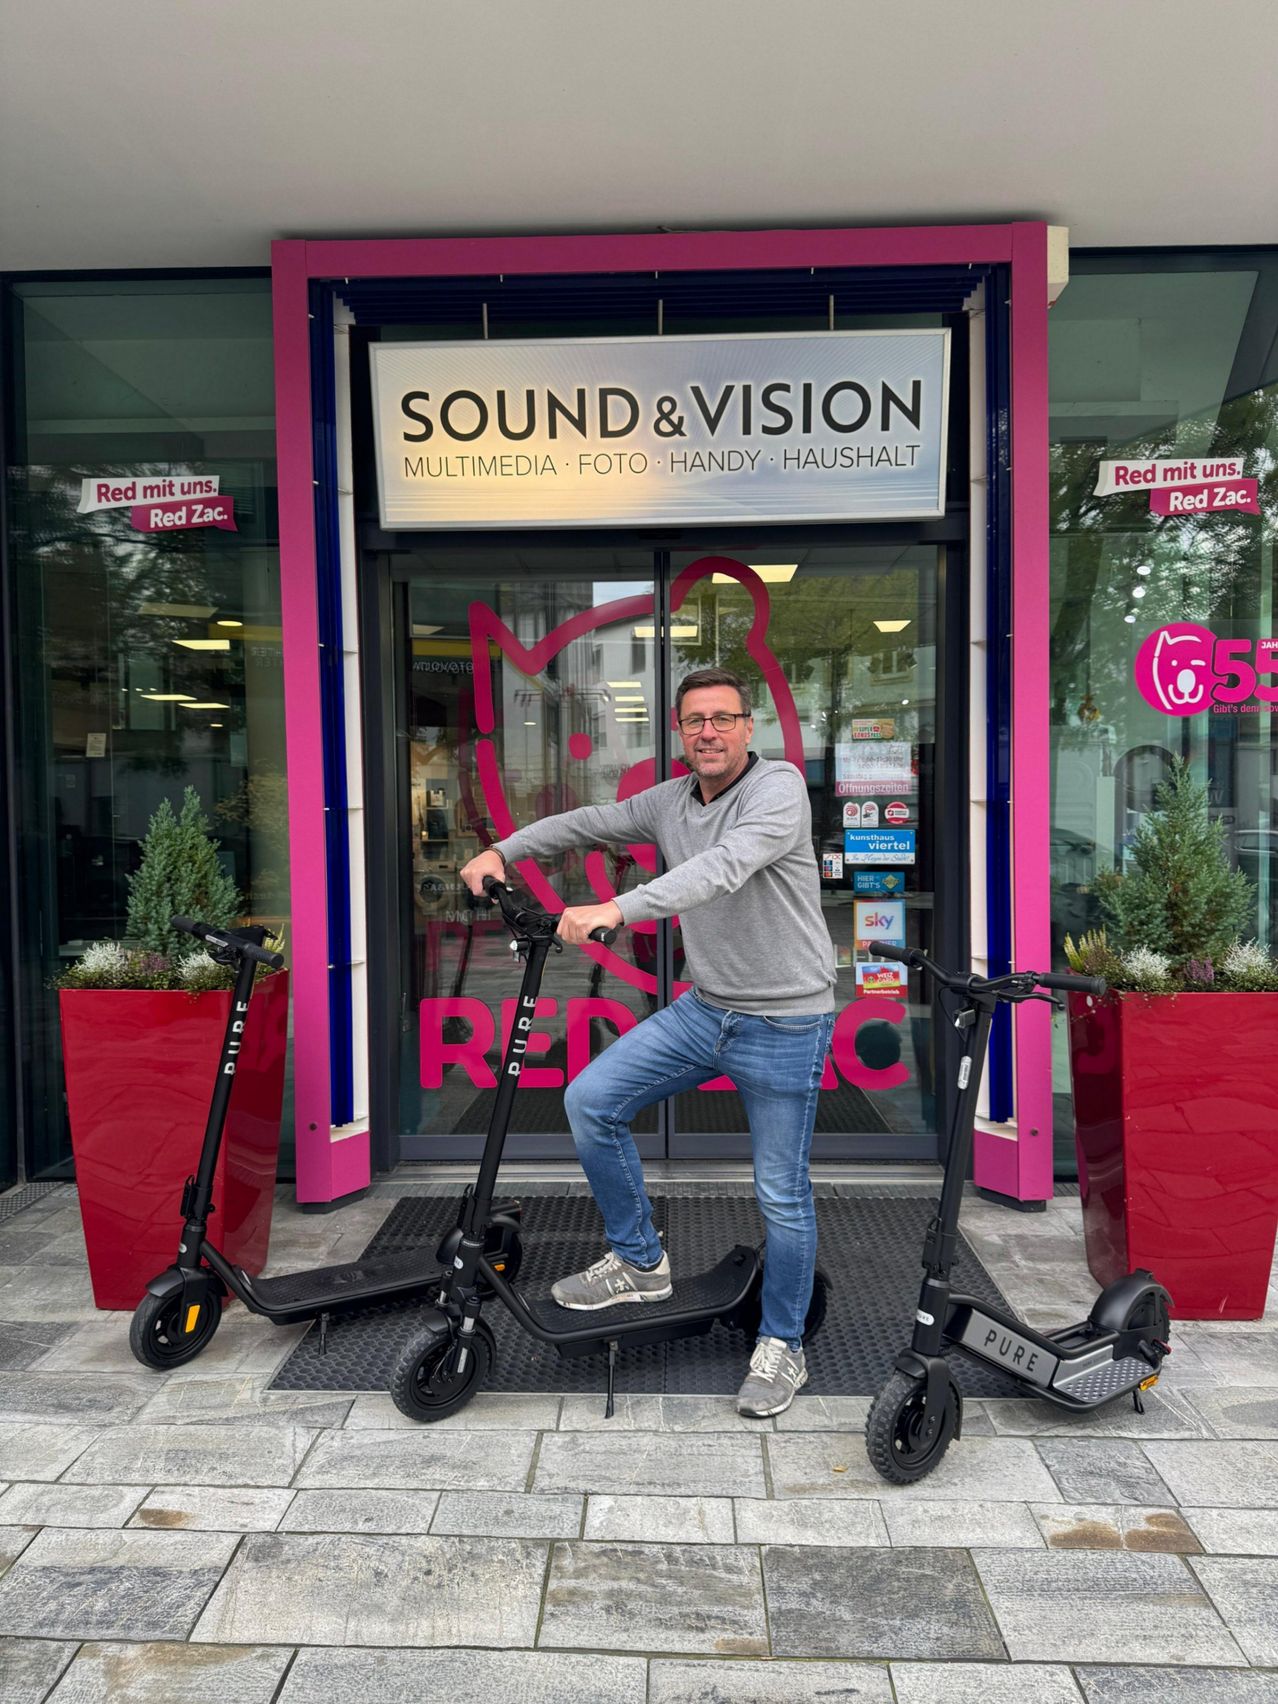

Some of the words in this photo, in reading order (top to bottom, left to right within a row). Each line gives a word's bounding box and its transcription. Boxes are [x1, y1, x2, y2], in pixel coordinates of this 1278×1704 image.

[401, 387, 640, 443] SOUND
[653, 395, 687, 438] &
[690, 380, 922, 438] VISION
[404, 454, 558, 478] MULTIMEDIA
[579, 452, 648, 475] FOTO
[671, 450, 761, 473] HANDY
[783, 445, 921, 470] HAUSHALT
[1115, 463, 1157, 486] Red
[1163, 461, 1197, 482] mit
[1202, 462, 1241, 478] uns.
[96, 481, 137, 503] Red
[143, 479, 175, 499] mit
[180, 479, 217, 496] uns.
[1169, 489, 1209, 512] Red
[1213, 487, 1252, 507] Zac.
[150, 505, 187, 528] Red
[191, 504, 228, 524] Zac.
[1213, 704, 1239, 713] Gibt's
[868, 841, 910, 850] viertel
[865, 912, 894, 930] sky
[223, 1001, 248, 1076] PURE
[508, 995, 536, 1077] PURE
[983, 1328, 1039, 1372] PURE
